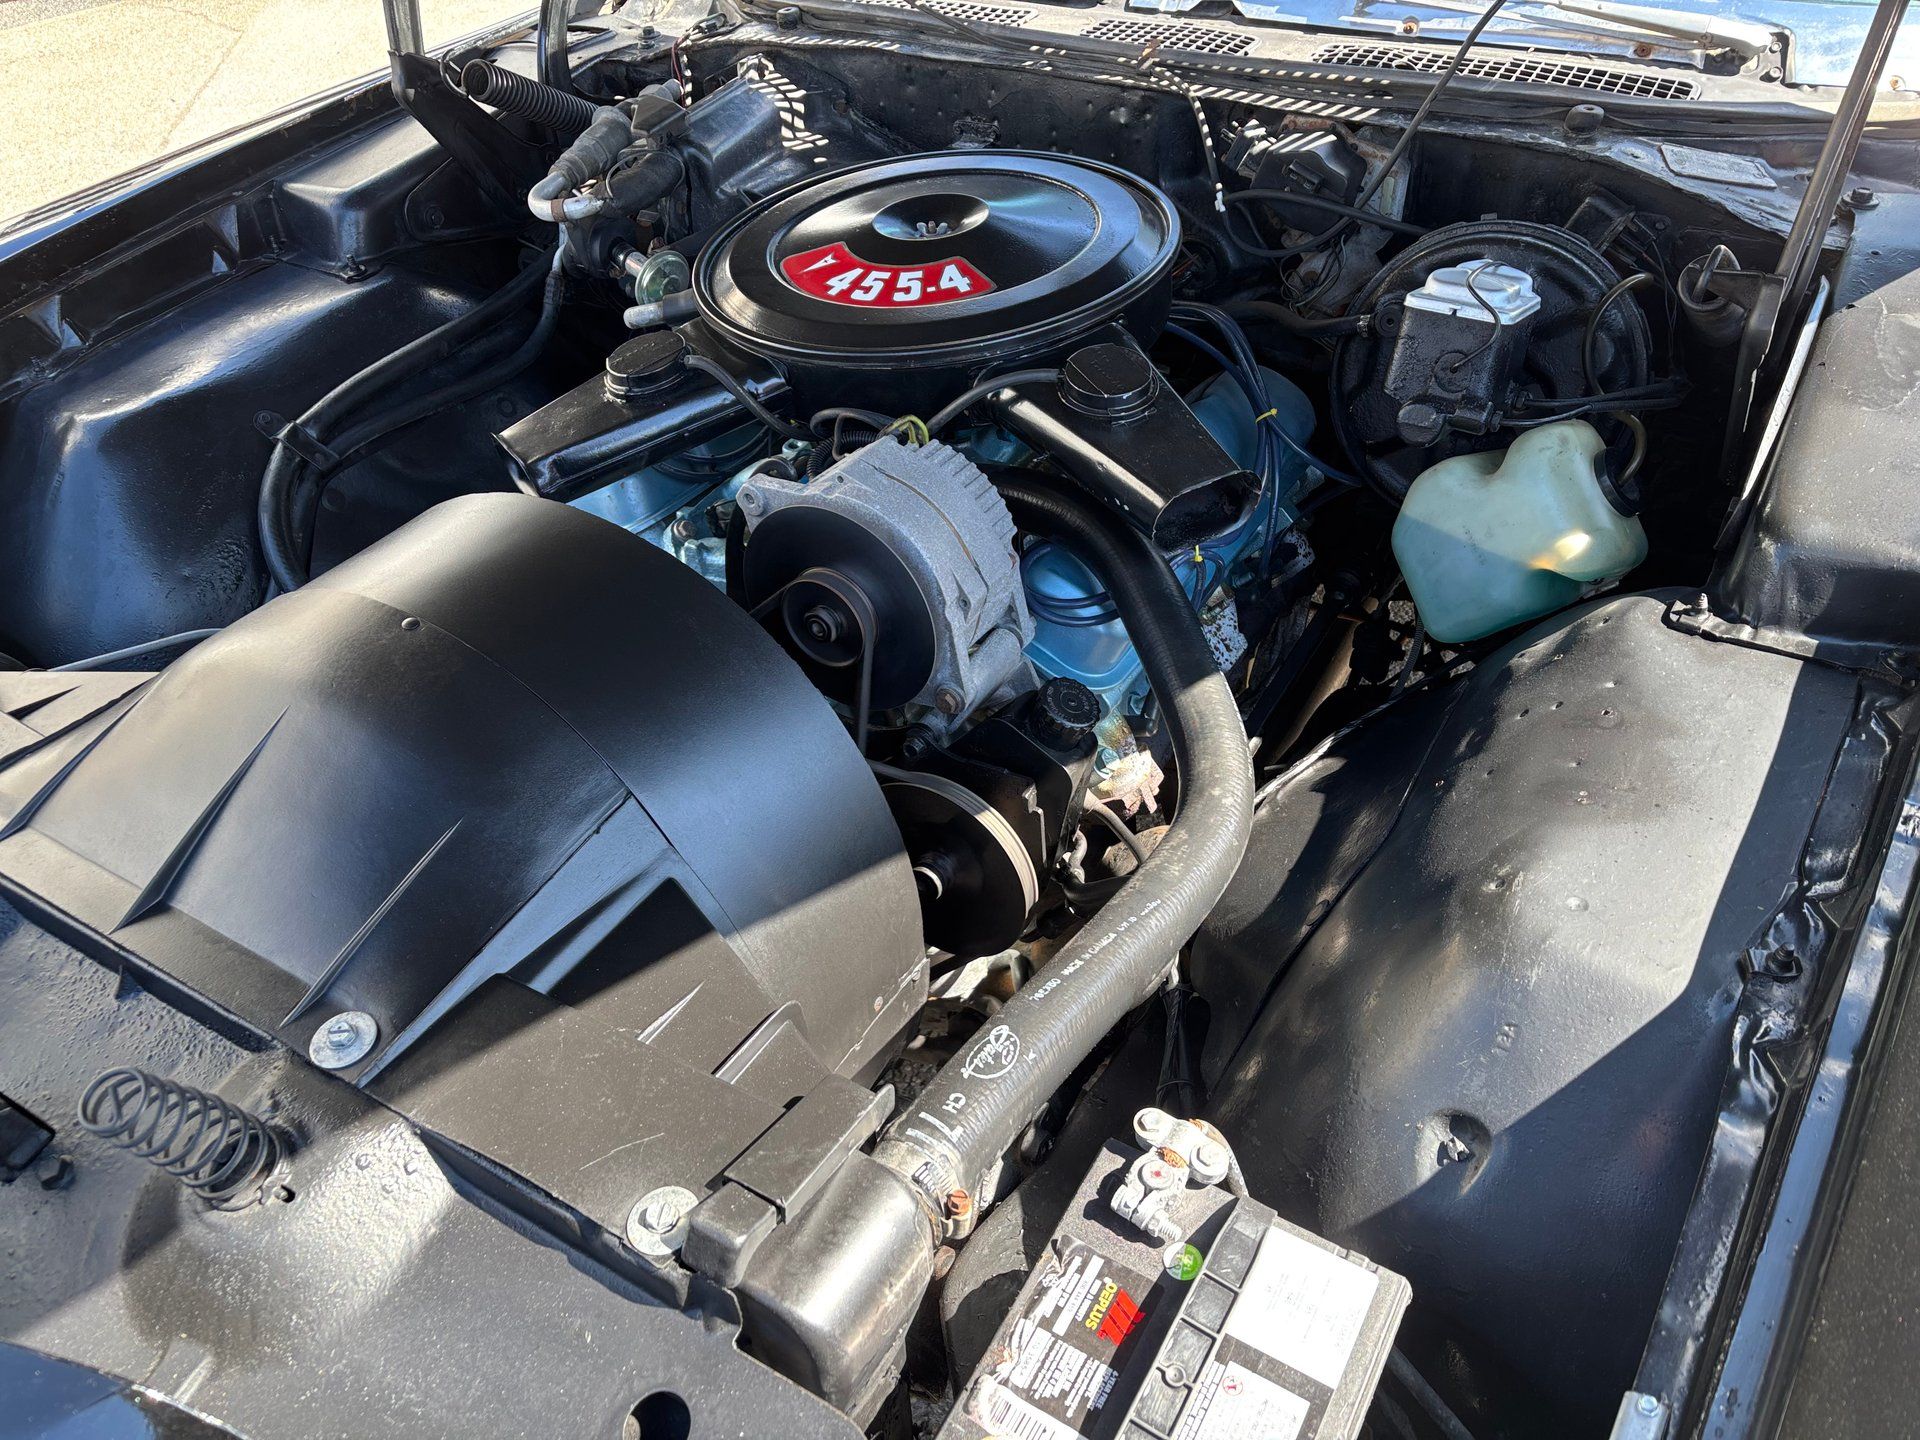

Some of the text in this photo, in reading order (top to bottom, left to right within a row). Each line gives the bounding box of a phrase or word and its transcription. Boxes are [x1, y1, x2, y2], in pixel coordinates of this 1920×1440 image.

[825, 264, 972, 302] 455-4
[1083, 1279, 1119, 1331] OEPLUS
[1094, 1369, 1119, 1409] 4-YEAR FREE
